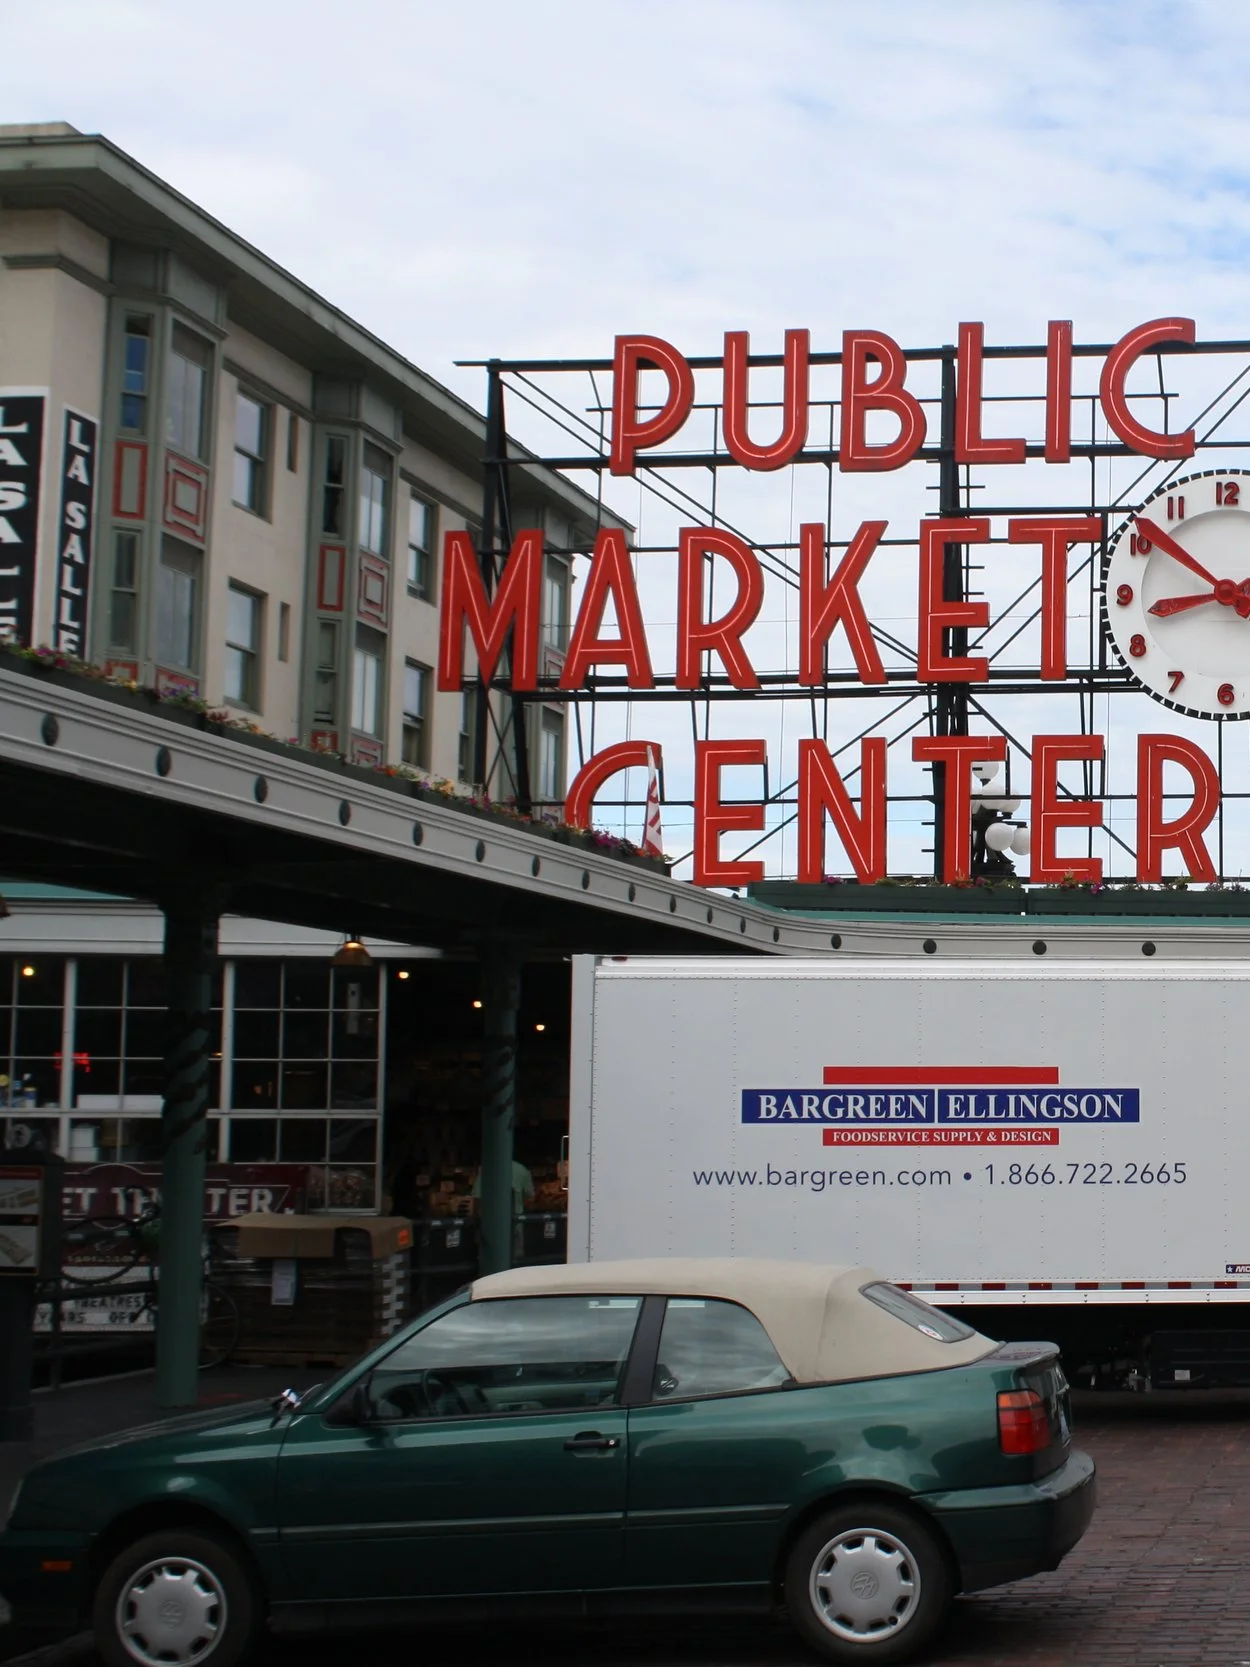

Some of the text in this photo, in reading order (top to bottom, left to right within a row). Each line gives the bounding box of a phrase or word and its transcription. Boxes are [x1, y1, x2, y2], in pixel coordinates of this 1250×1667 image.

[609, 317, 1196, 477] PUBLIC
[66, 418, 91, 486] LA
[1216, 481, 1240, 505] 12
[1167, 496, 1185, 520] 11
[1129, 533, 1152, 556] 10
[437, 516, 1103, 693] MARKET
[1116, 584, 1134, 606] 9
[1129, 634, 1147, 658] 8
[1167, 671, 1185, 693] 7
[1217, 683, 1235, 706] 6
[564, 733, 1221, 887] CENTER
[758, 1094, 1124, 1120] BARGREEN ELLINGSON
[833, 1131, 1052, 1143] FOODSERVICE SUPPLY & DESIGN
[693, 1162, 1187, 1192] www.bargreen.com 1.866.722.2665
